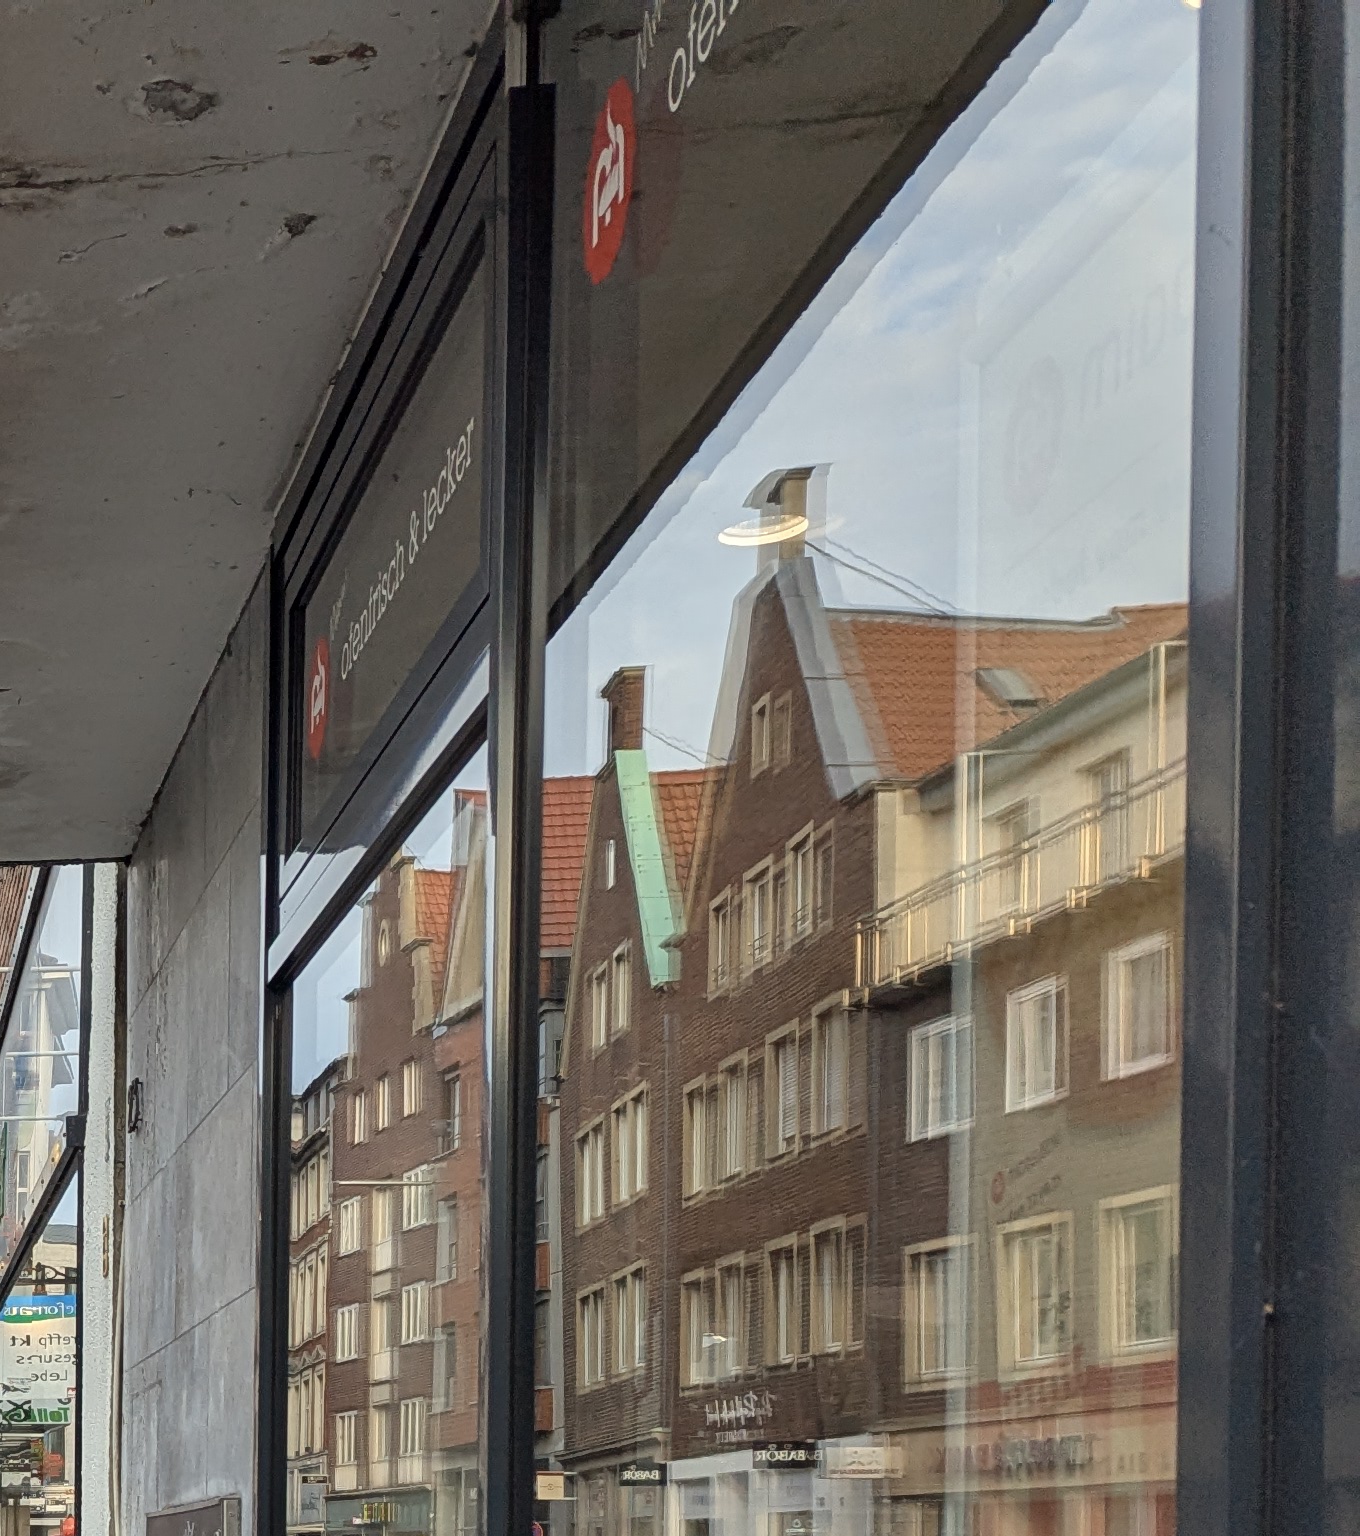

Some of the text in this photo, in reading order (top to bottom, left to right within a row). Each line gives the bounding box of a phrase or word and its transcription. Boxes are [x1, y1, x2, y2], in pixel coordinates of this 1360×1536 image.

[341, 416, 475, 680] ofenfrisch & lecker
